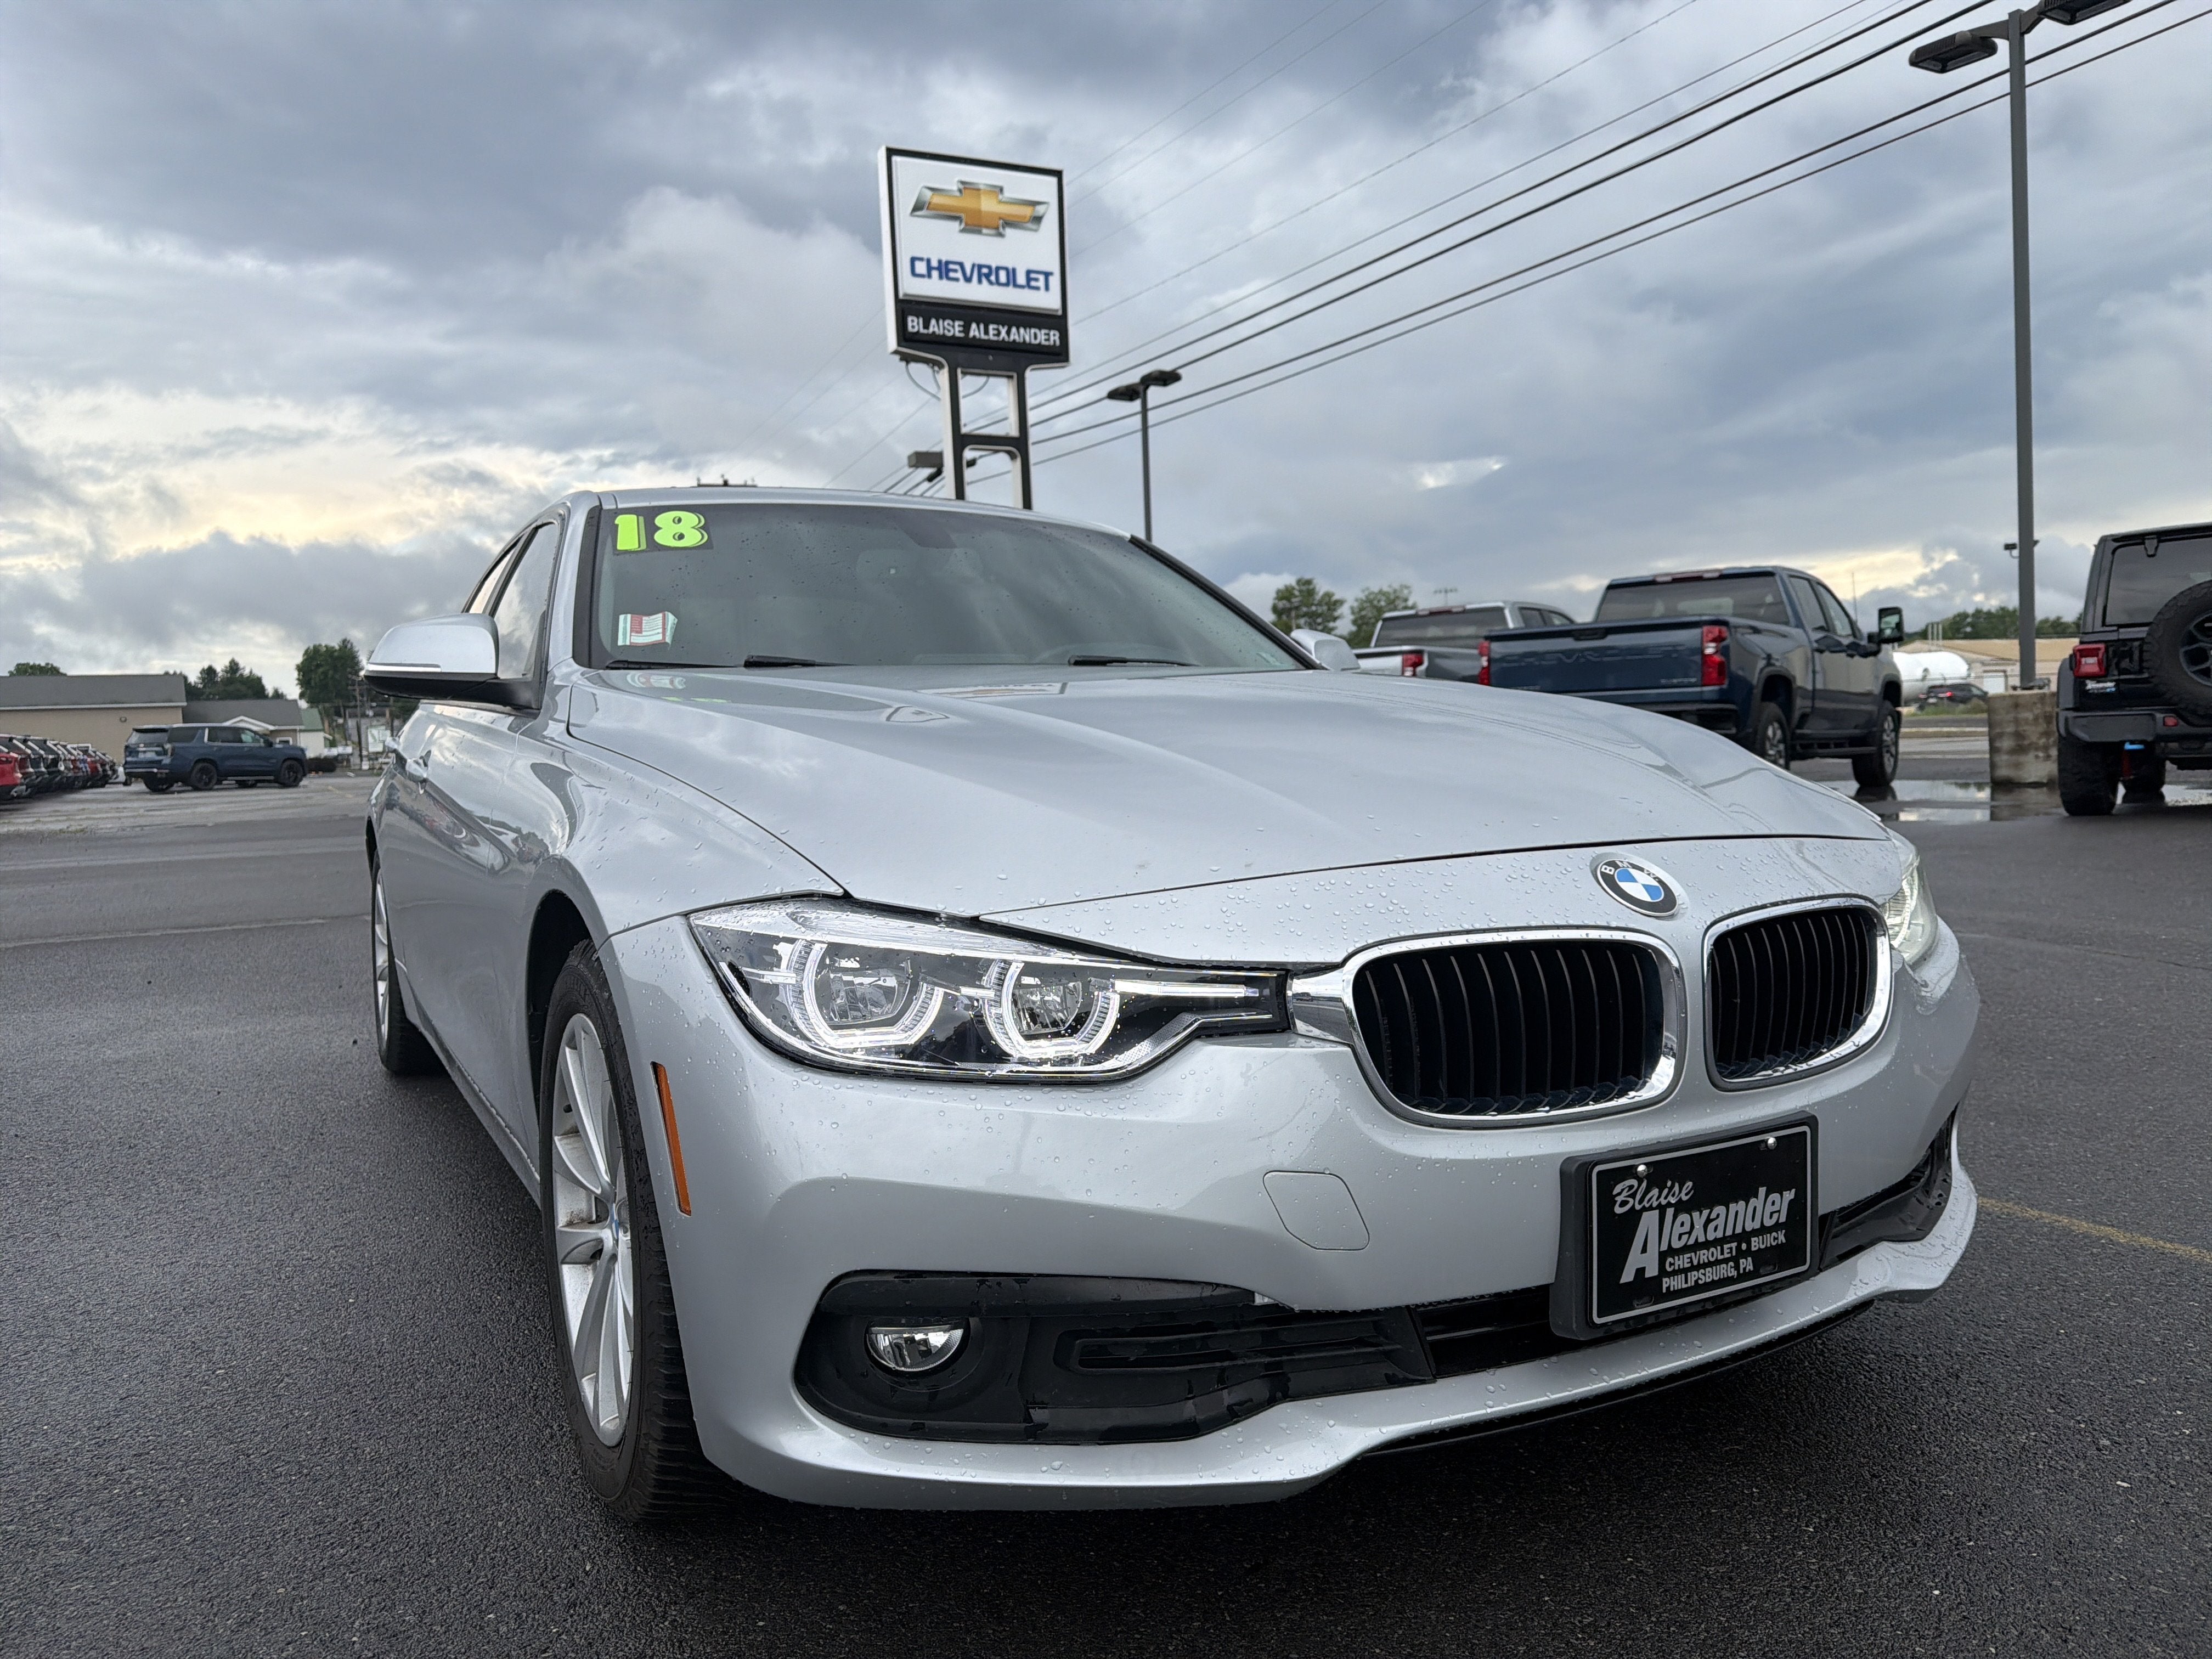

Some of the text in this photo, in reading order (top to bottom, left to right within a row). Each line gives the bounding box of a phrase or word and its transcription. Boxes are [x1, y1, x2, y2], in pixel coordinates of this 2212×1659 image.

[910, 256, 1054, 292] CHEVROLET
[907, 315, 1060, 347] BLAISE ALEXANDER
[614, 510, 708, 551] 18
[1601, 860, 1660, 881] BMW
[1612, 1178, 1695, 1215] Blaise
[1619, 1187, 1796, 1285] Alexander
[1665, 1229, 1786, 1272] CHEVROLET BUICK
[1662, 1257, 1754, 1294] PHILIPSBURG, PA
